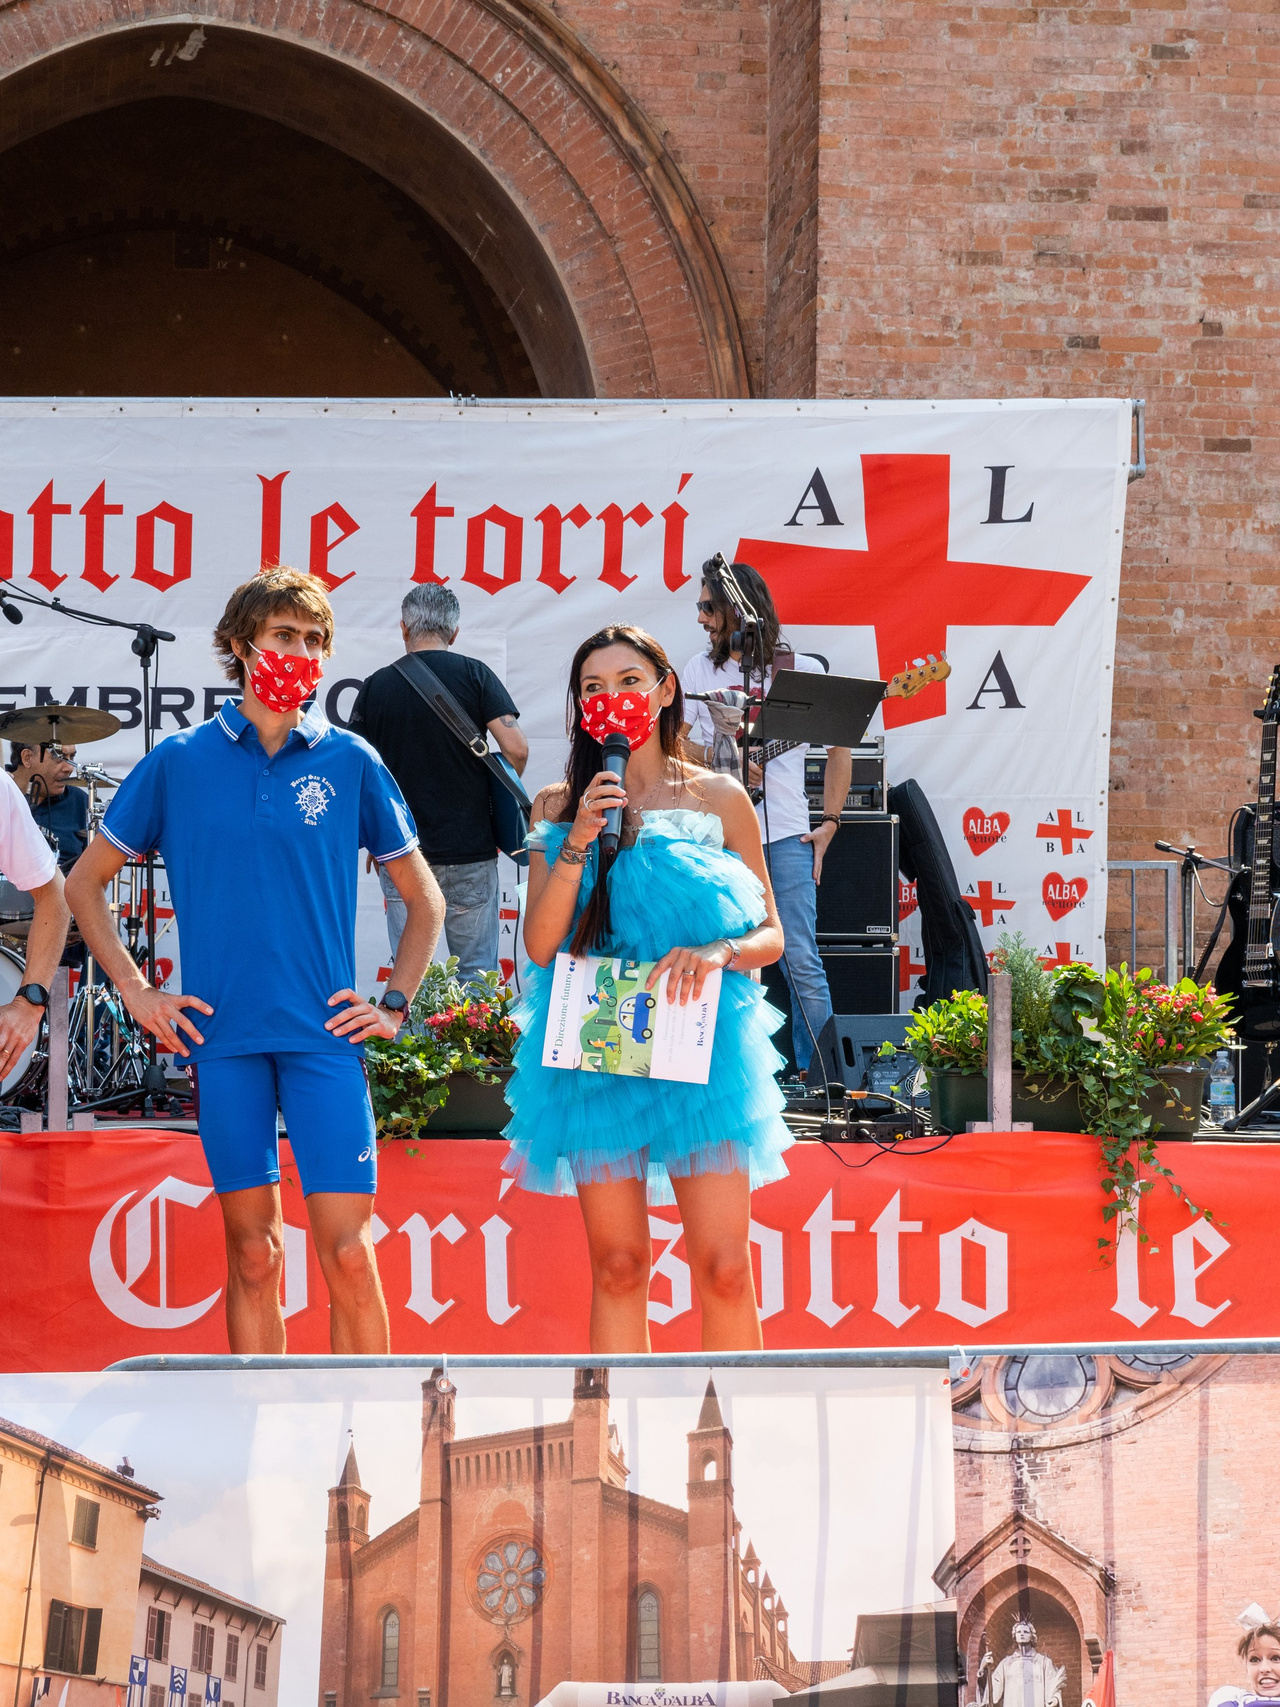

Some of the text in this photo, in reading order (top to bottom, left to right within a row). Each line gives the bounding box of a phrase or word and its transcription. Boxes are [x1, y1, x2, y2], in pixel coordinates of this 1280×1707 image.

[784, 465, 1034, 527] A L
[256, 470, 361, 592] le
[410, 473, 694, 595] torri
[966, 651, 1027, 710] A
[968, 818, 1002, 835] ALBA
[1047, 883, 1080, 900] ALBA
[555, 973, 572, 1048] Direzione futuro
[89, 1175, 522, 1329] Cri
[1110, 1180, 1233, 1329] le
[606, 1691, 655, 1707] BANCA
